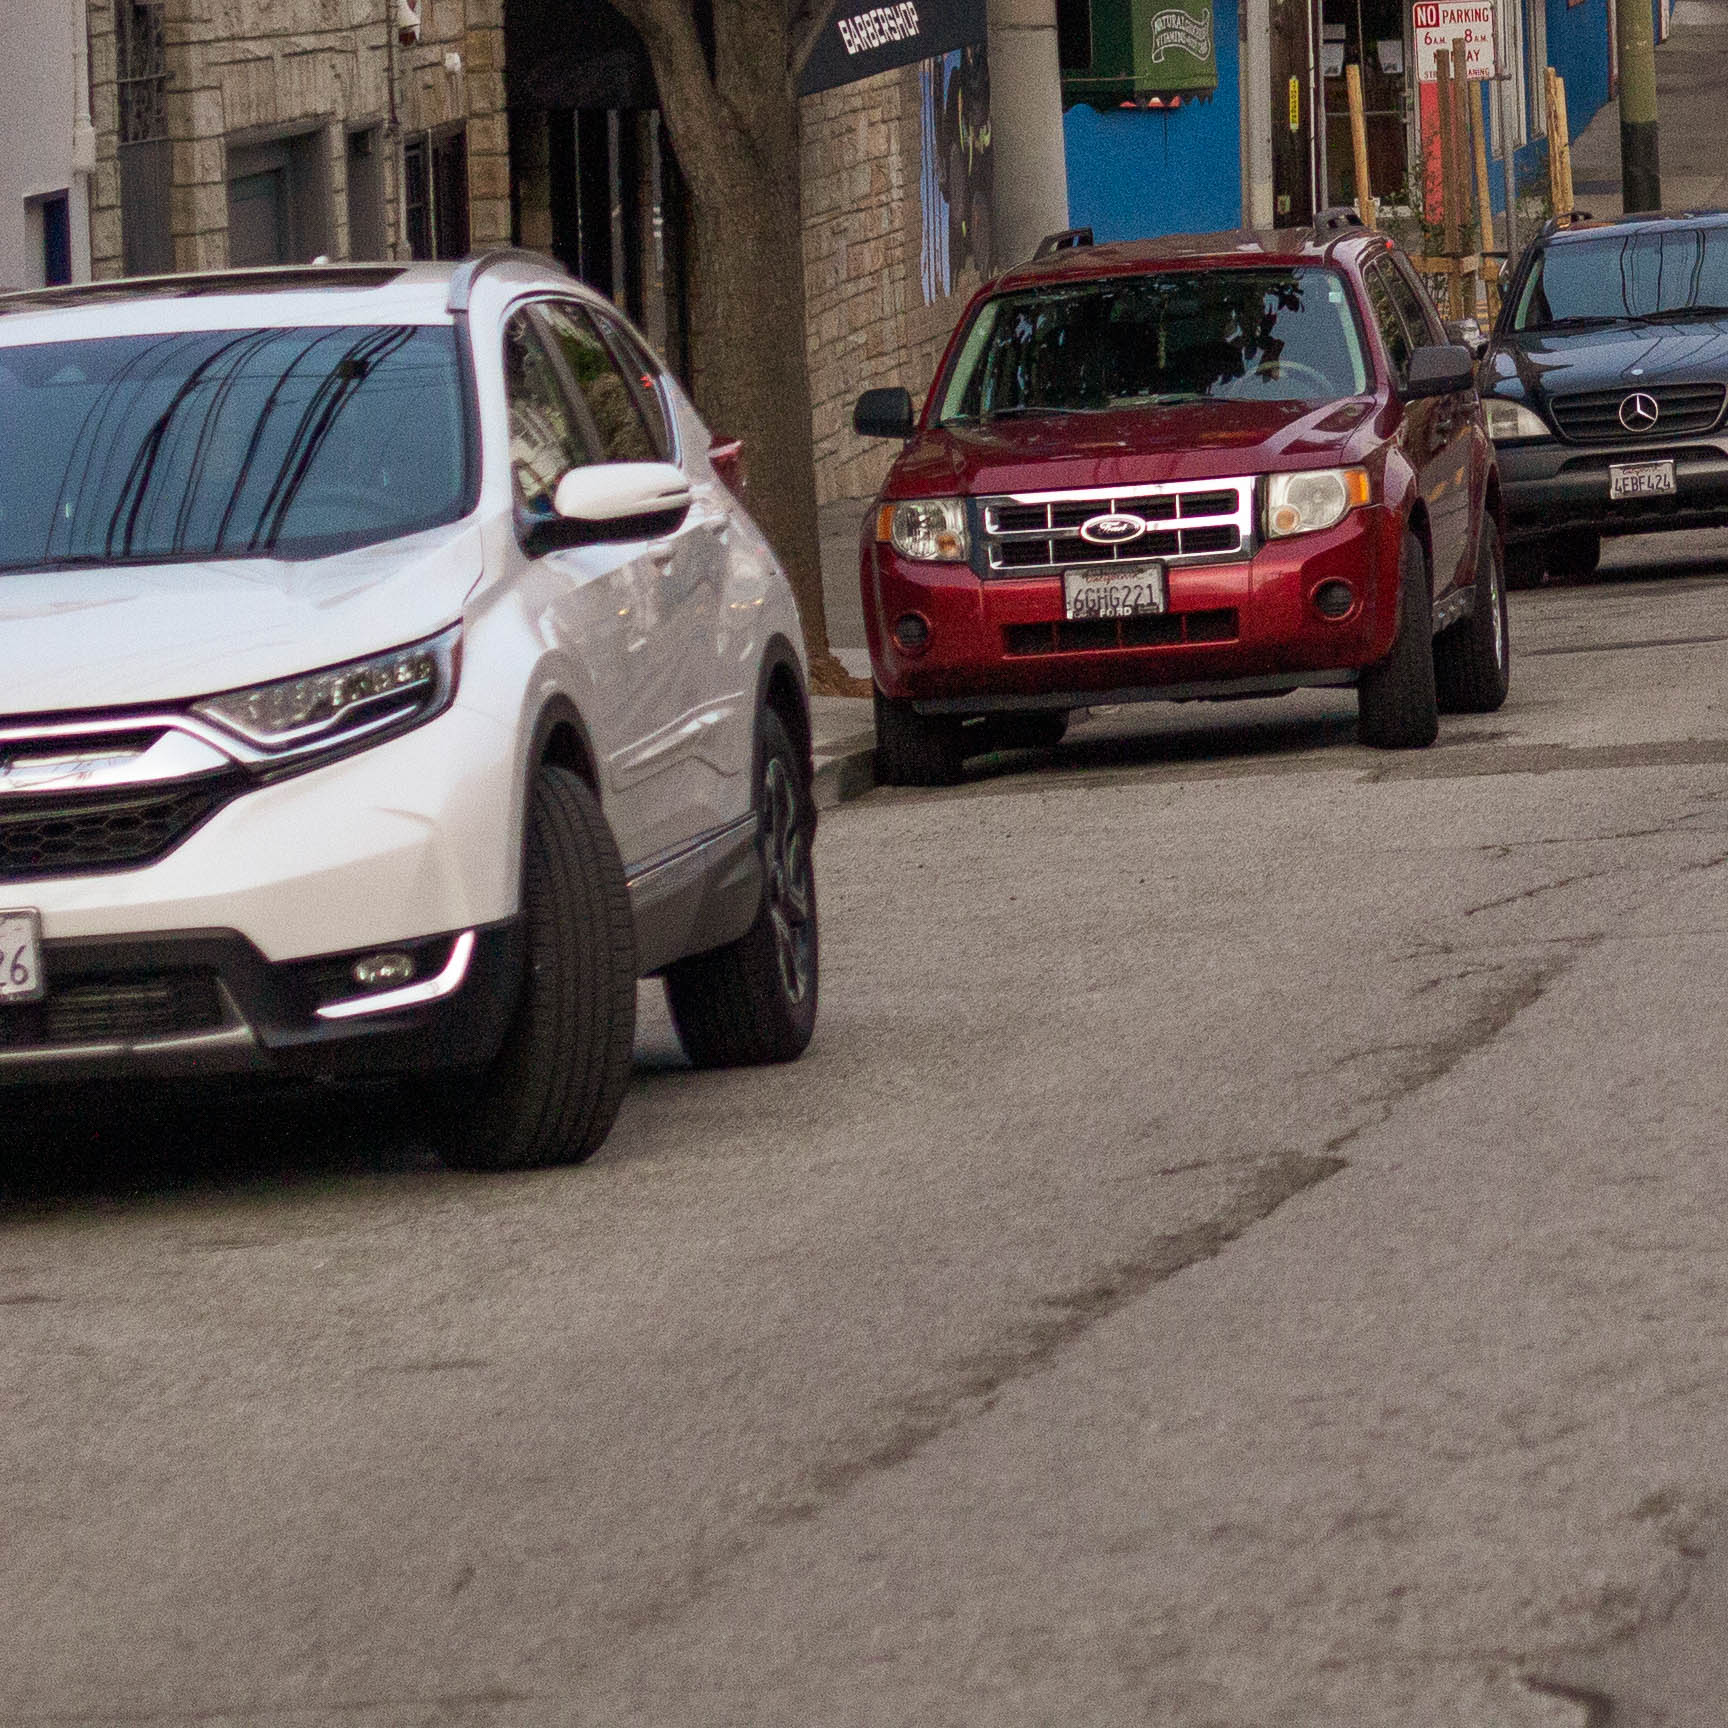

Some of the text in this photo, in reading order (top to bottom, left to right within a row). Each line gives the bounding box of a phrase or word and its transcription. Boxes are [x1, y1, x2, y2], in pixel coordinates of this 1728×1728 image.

[1416, 5, 1489, 27] NO PARKING
[837, 0, 920, 56] BARBERSHOP
[1424, 31, 1433, 46] 6
[1464, 28, 1473, 43] 8
[1614, 474, 1671, 493] 4EBF424
[1073, 583, 1158, 612] 6GHG221
[1099, 606, 1133, 619] FORD
